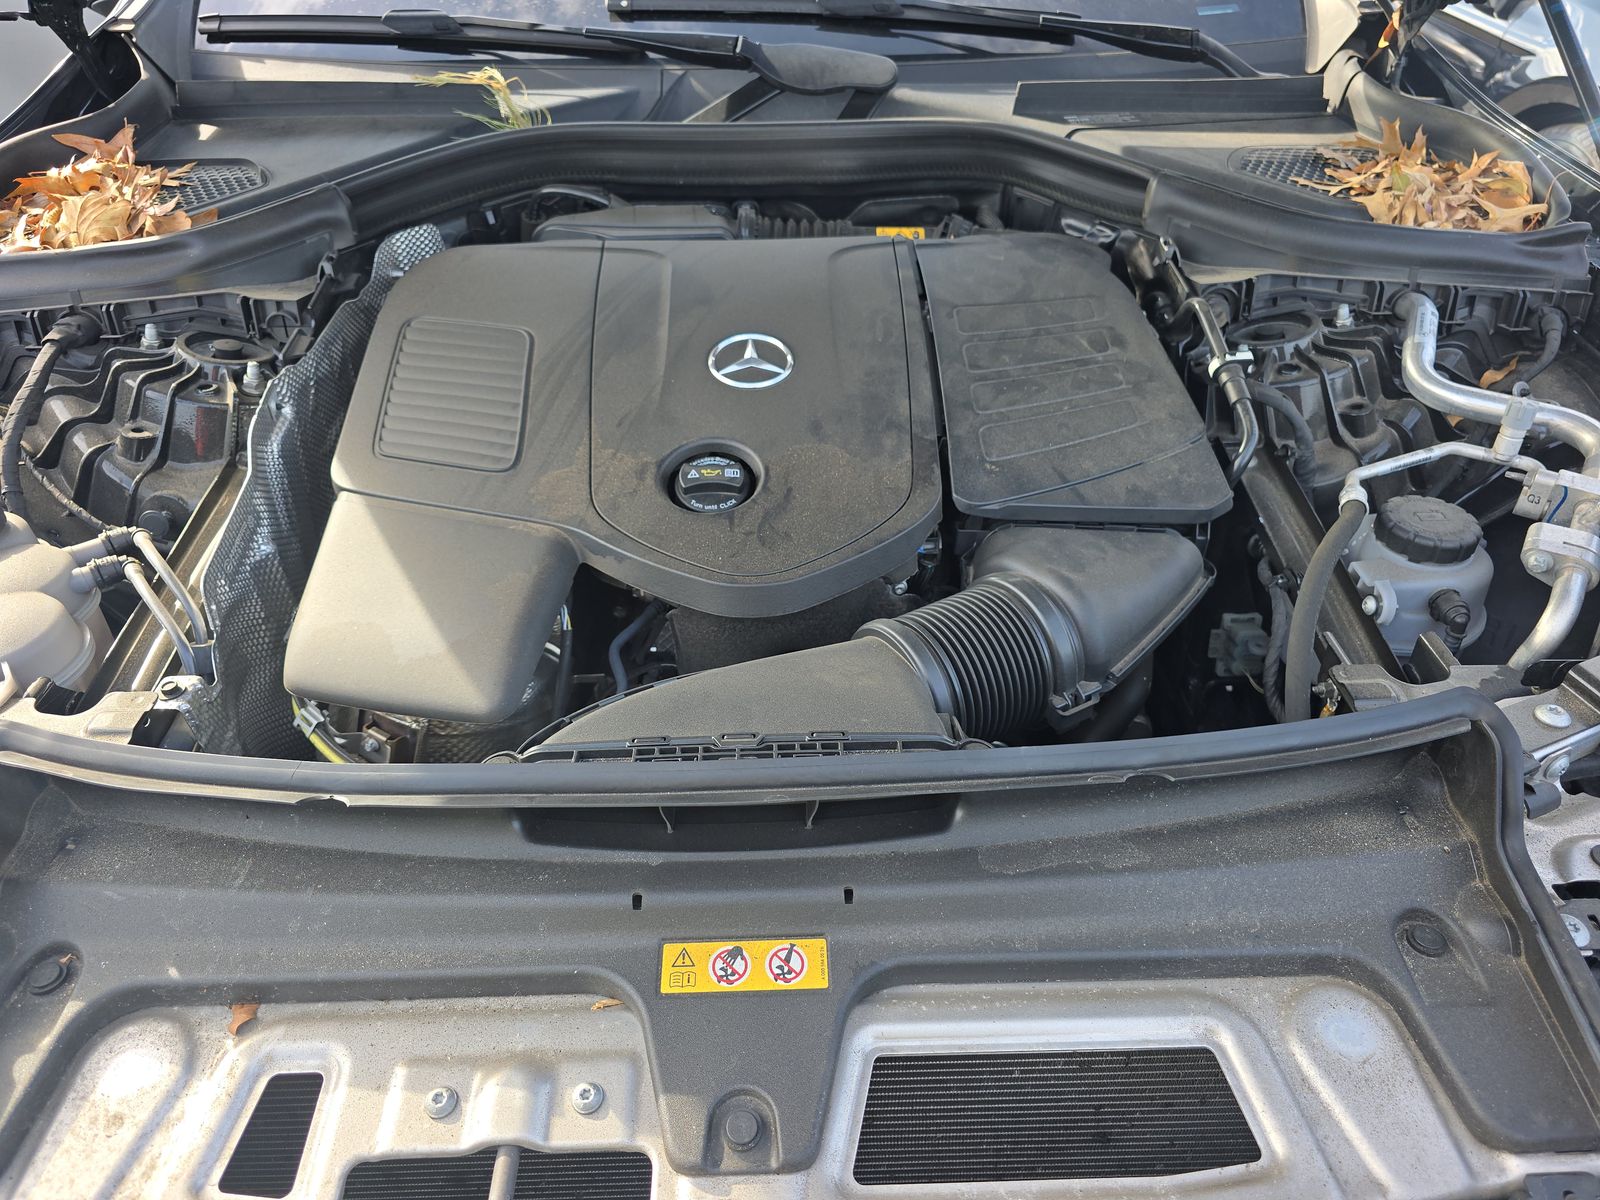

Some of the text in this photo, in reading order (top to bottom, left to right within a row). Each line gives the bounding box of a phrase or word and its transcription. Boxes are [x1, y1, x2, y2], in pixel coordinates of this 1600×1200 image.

[690, 499, 703, 509] Turn
[719, 498, 737, 509] CLICK
[1527, 493, 1541, 505] Q3
